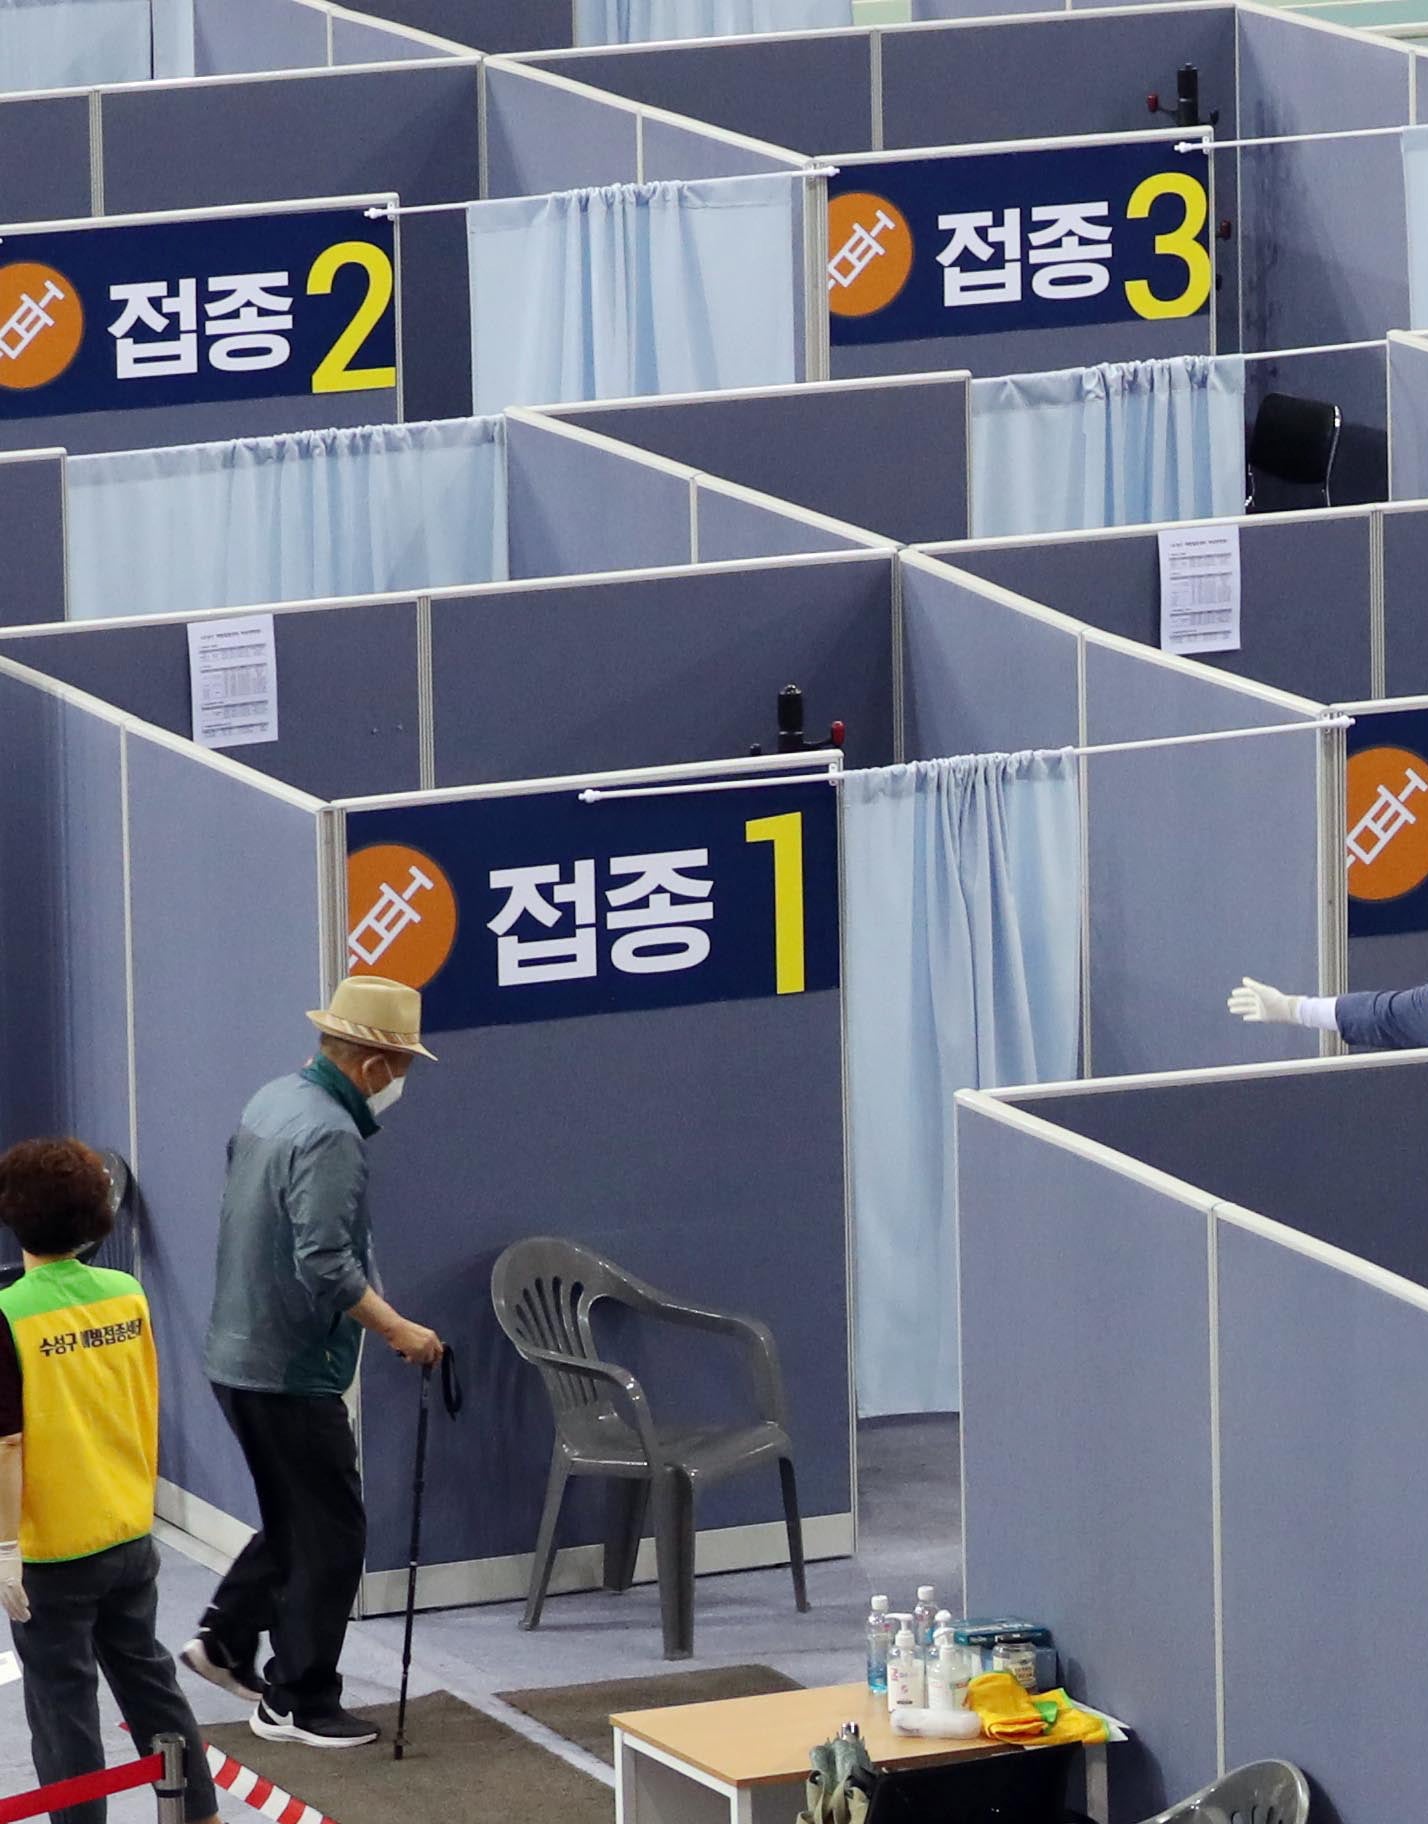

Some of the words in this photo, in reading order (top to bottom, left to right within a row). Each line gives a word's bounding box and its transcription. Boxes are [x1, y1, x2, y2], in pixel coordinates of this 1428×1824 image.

[108, 271, 293, 379] 접종
[307, 241, 397, 393] 2
[936, 202, 1112, 307] 접종
[1127, 173, 1211, 319] 3
[487, 848, 714, 987] 접종
[745, 812, 805, 995] 1
[40, 1332, 78, 1357] 수성구
